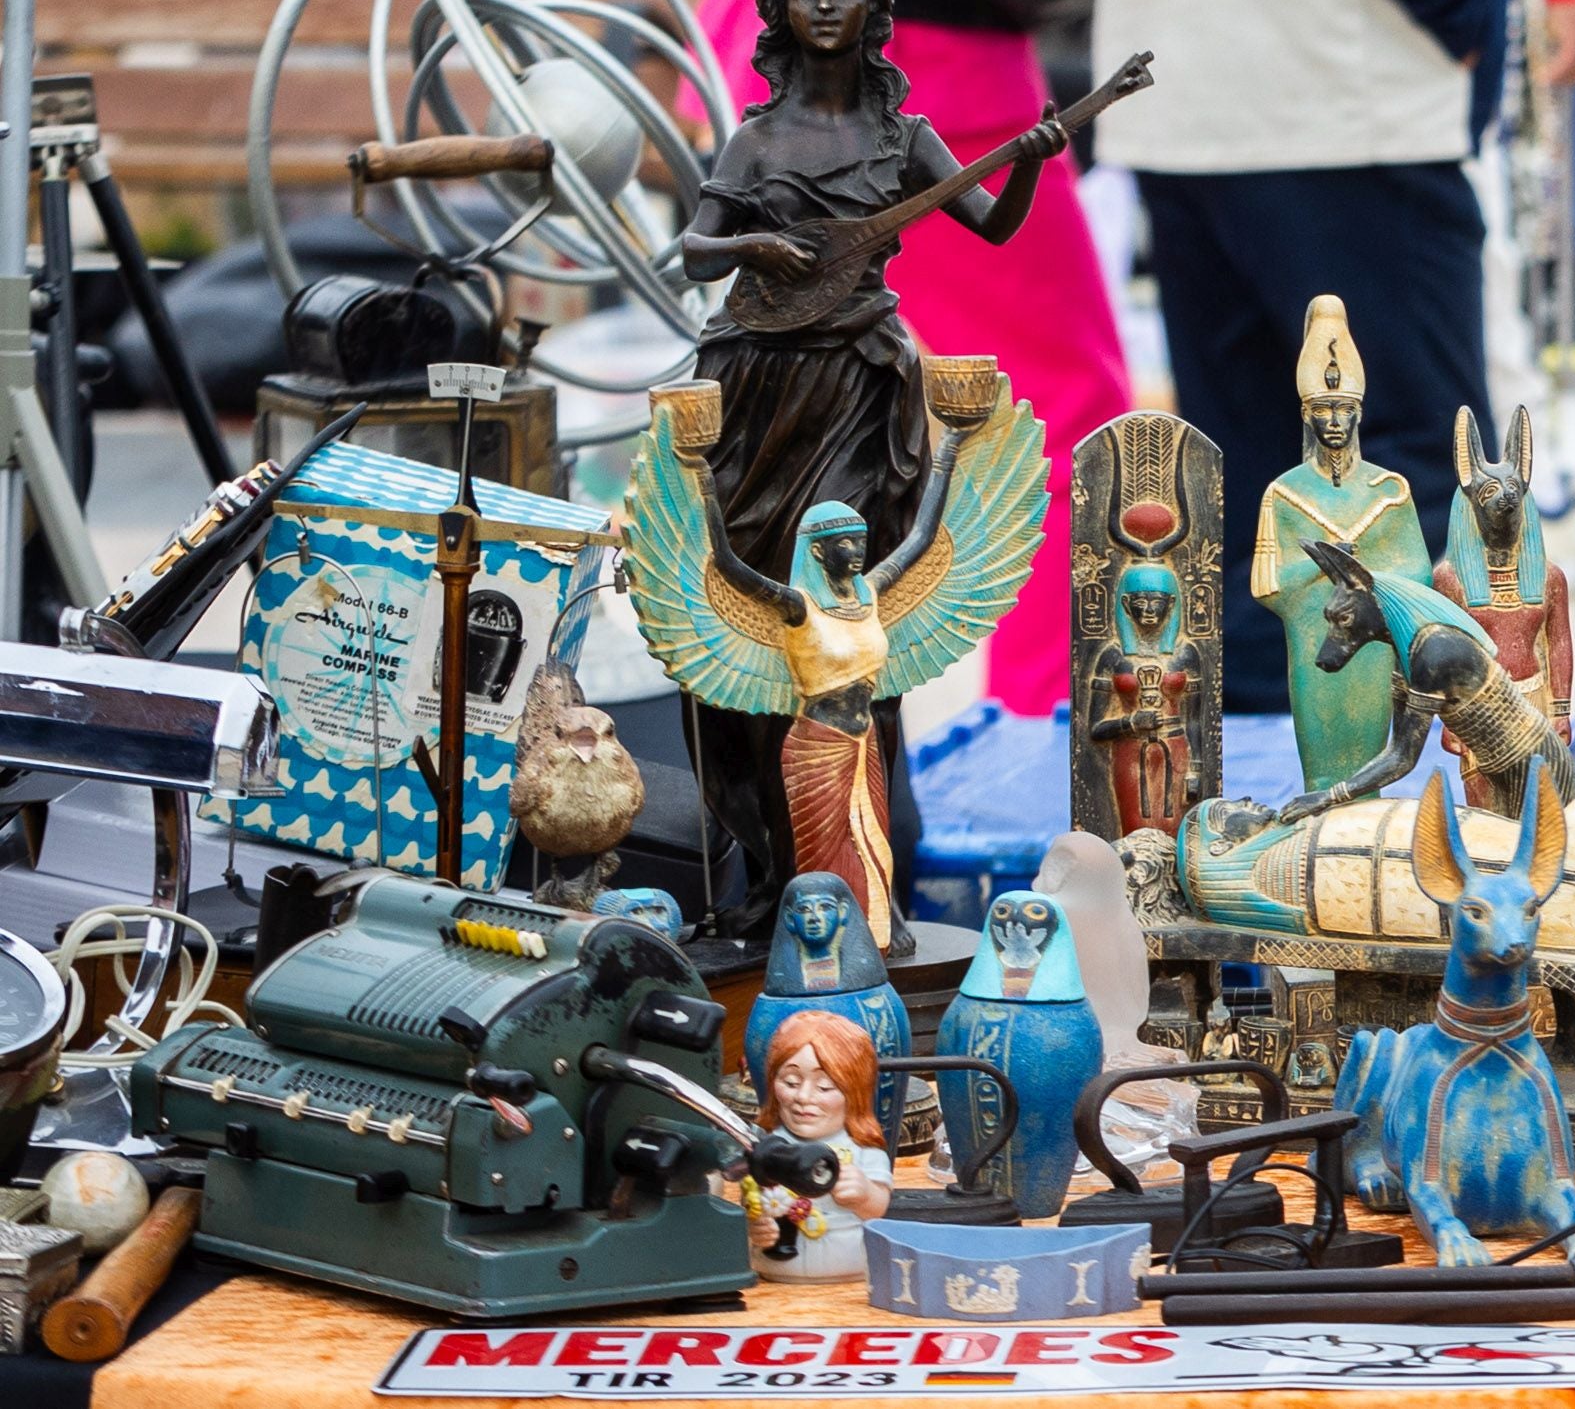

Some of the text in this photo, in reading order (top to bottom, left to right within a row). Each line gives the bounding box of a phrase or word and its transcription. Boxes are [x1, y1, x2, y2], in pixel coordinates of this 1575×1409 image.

[377, 603, 409, 619] 66-B
[322, 654, 398, 682] COMPASS
[424, 1330, 1180, 1367] MERCEDES
[568, 1371, 897, 1388] TIR 2023
